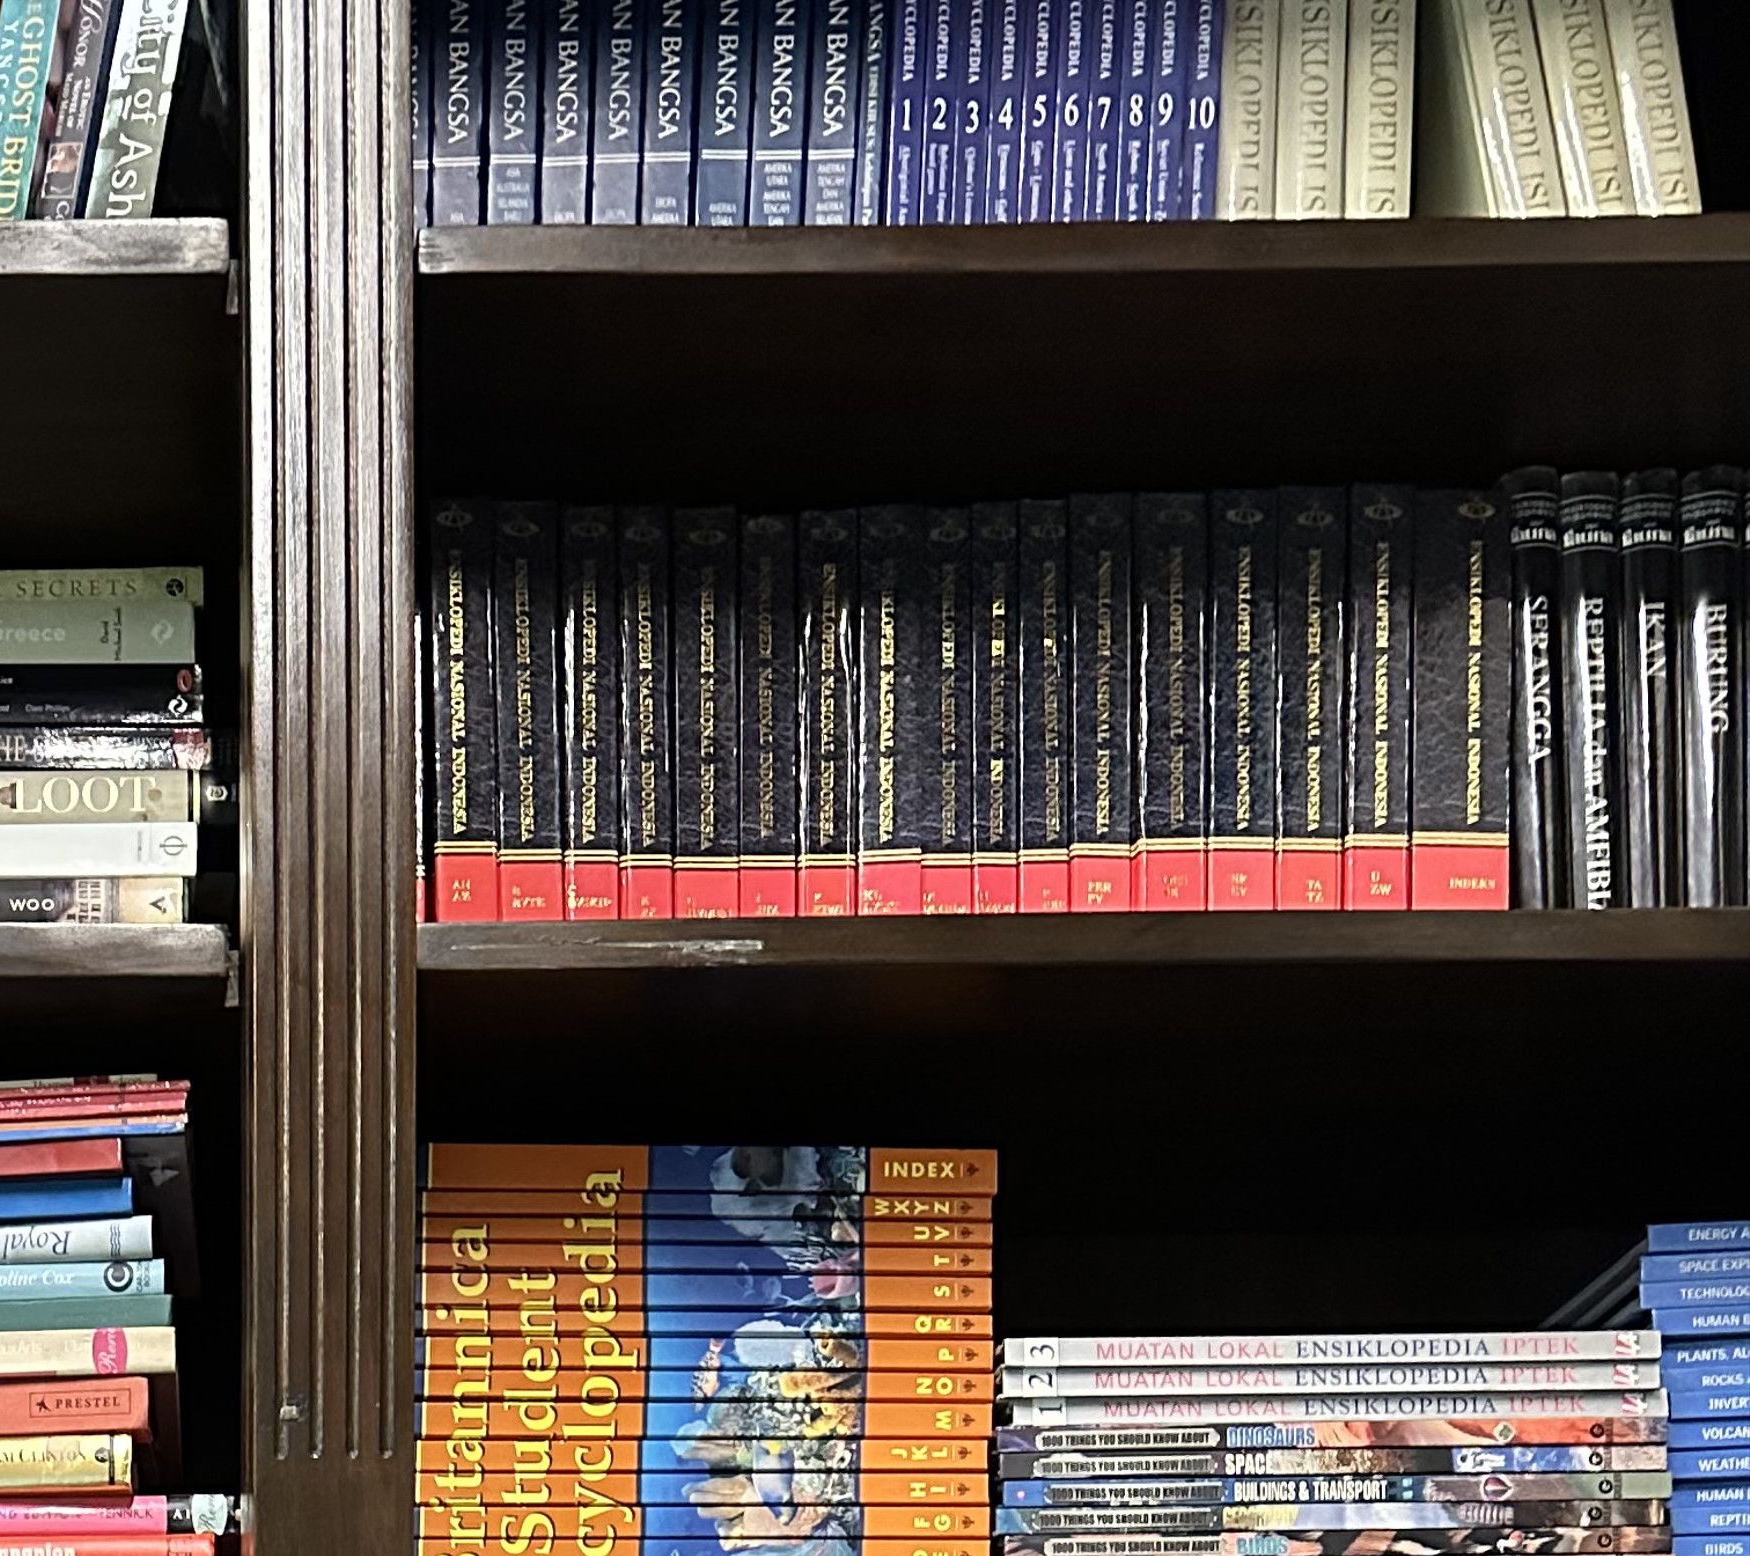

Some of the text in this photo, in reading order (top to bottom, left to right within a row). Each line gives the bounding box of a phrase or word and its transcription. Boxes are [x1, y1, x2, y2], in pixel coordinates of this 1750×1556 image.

[17, 579, 138, 597] SECRETS
[14, 777, 156, 812] LOOT
[9, 898, 55, 911] WOO
[884, 1163, 954, 1178] INDEX
[1096, 1336, 1579, 1359] MUATAN LOKAL ENSIKLOPEDIA IPTEK
[56, 1396, 120, 1409] PRESTEL
[501, 1270, 557, 1555] Student
